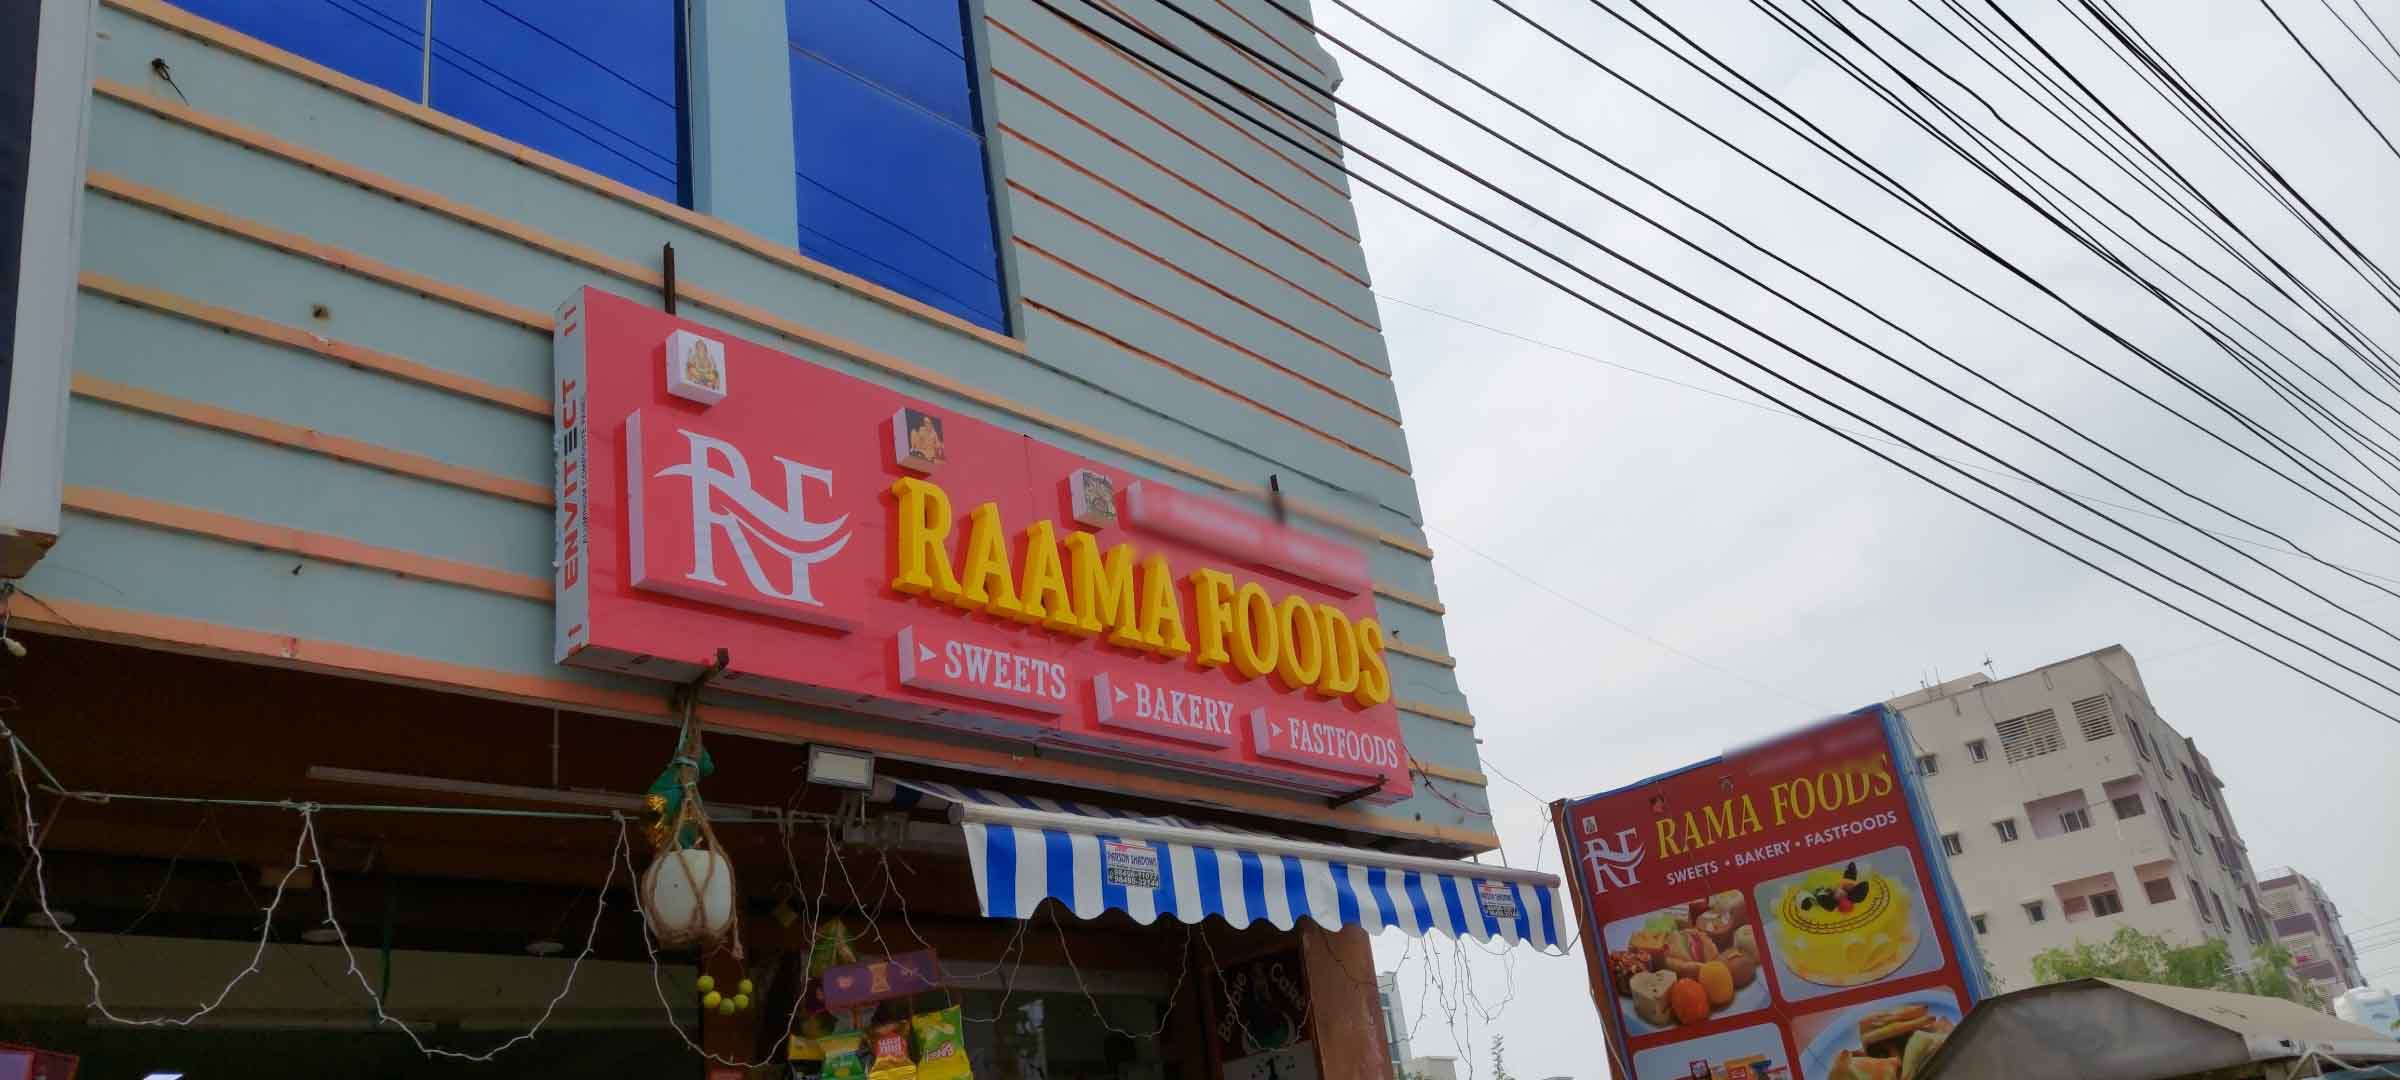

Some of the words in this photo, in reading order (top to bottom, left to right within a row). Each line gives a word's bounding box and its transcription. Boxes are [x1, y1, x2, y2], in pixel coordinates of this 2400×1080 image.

[562, 379, 578, 592] ENVITECT
[890, 477, 1191, 657] RAAMA
[1190, 567, 1392, 706] FOODS
[943, 640, 1067, 699] SWEETS
[1135, 686, 1235, 735] BAKERY
[1287, 717, 1399, 769] FASTFOODS
[1655, 793, 1763, 860] RAMA
[1770, 754, 1893, 826] FOODS
[1666, 860, 1719, 886] SWEETS
[1734, 838, 1792, 867] BAKERY
[1805, 811, 1897, 848] FASTFOODS
